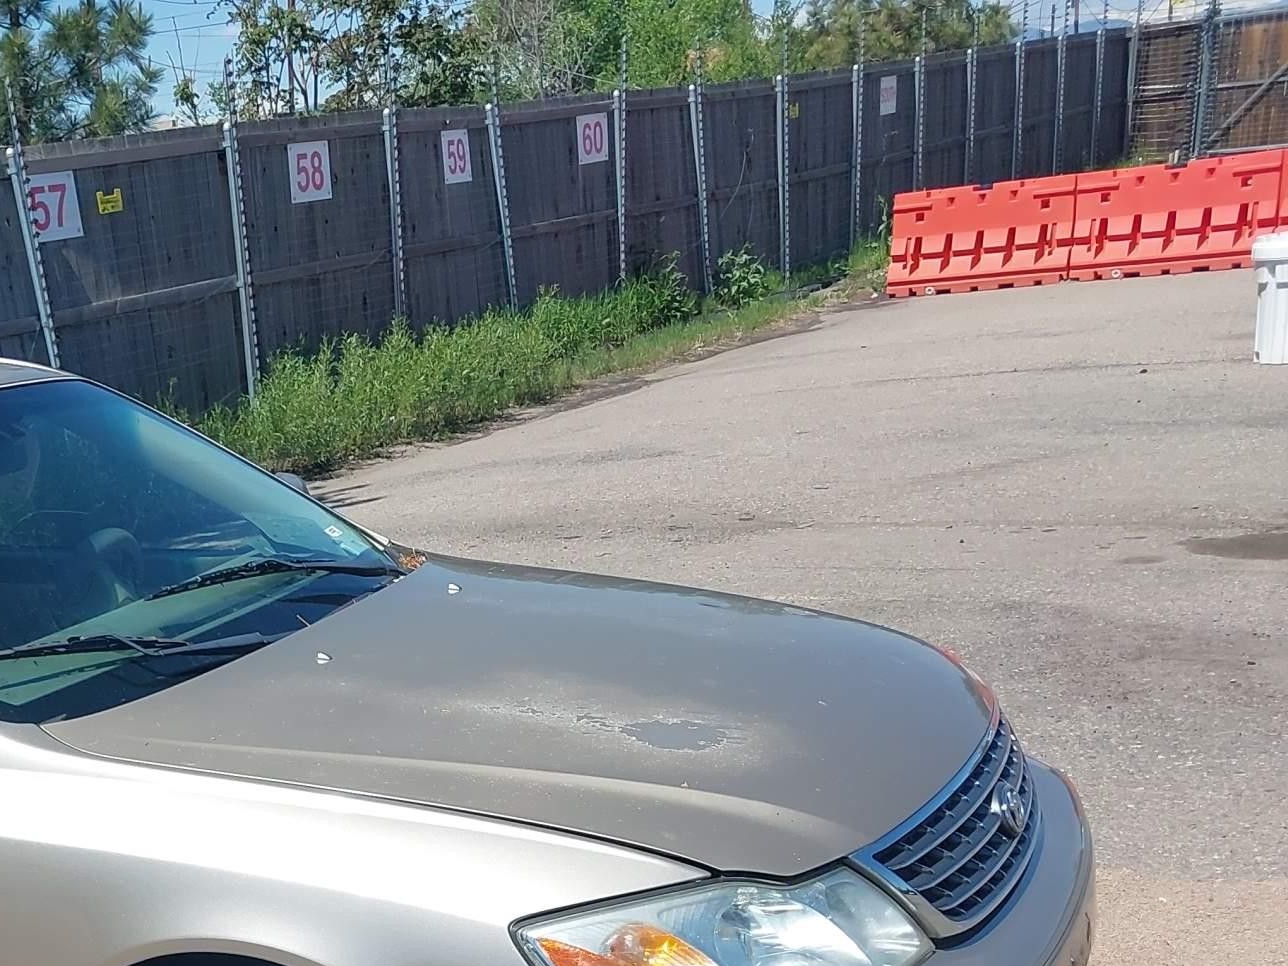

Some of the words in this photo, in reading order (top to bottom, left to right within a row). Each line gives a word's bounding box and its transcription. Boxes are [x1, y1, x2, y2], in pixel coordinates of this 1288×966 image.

[447, 138, 466, 175] 59
[583, 121, 603, 155] 60
[296, 151, 324, 192] 58
[30, 184, 66, 231] 57
